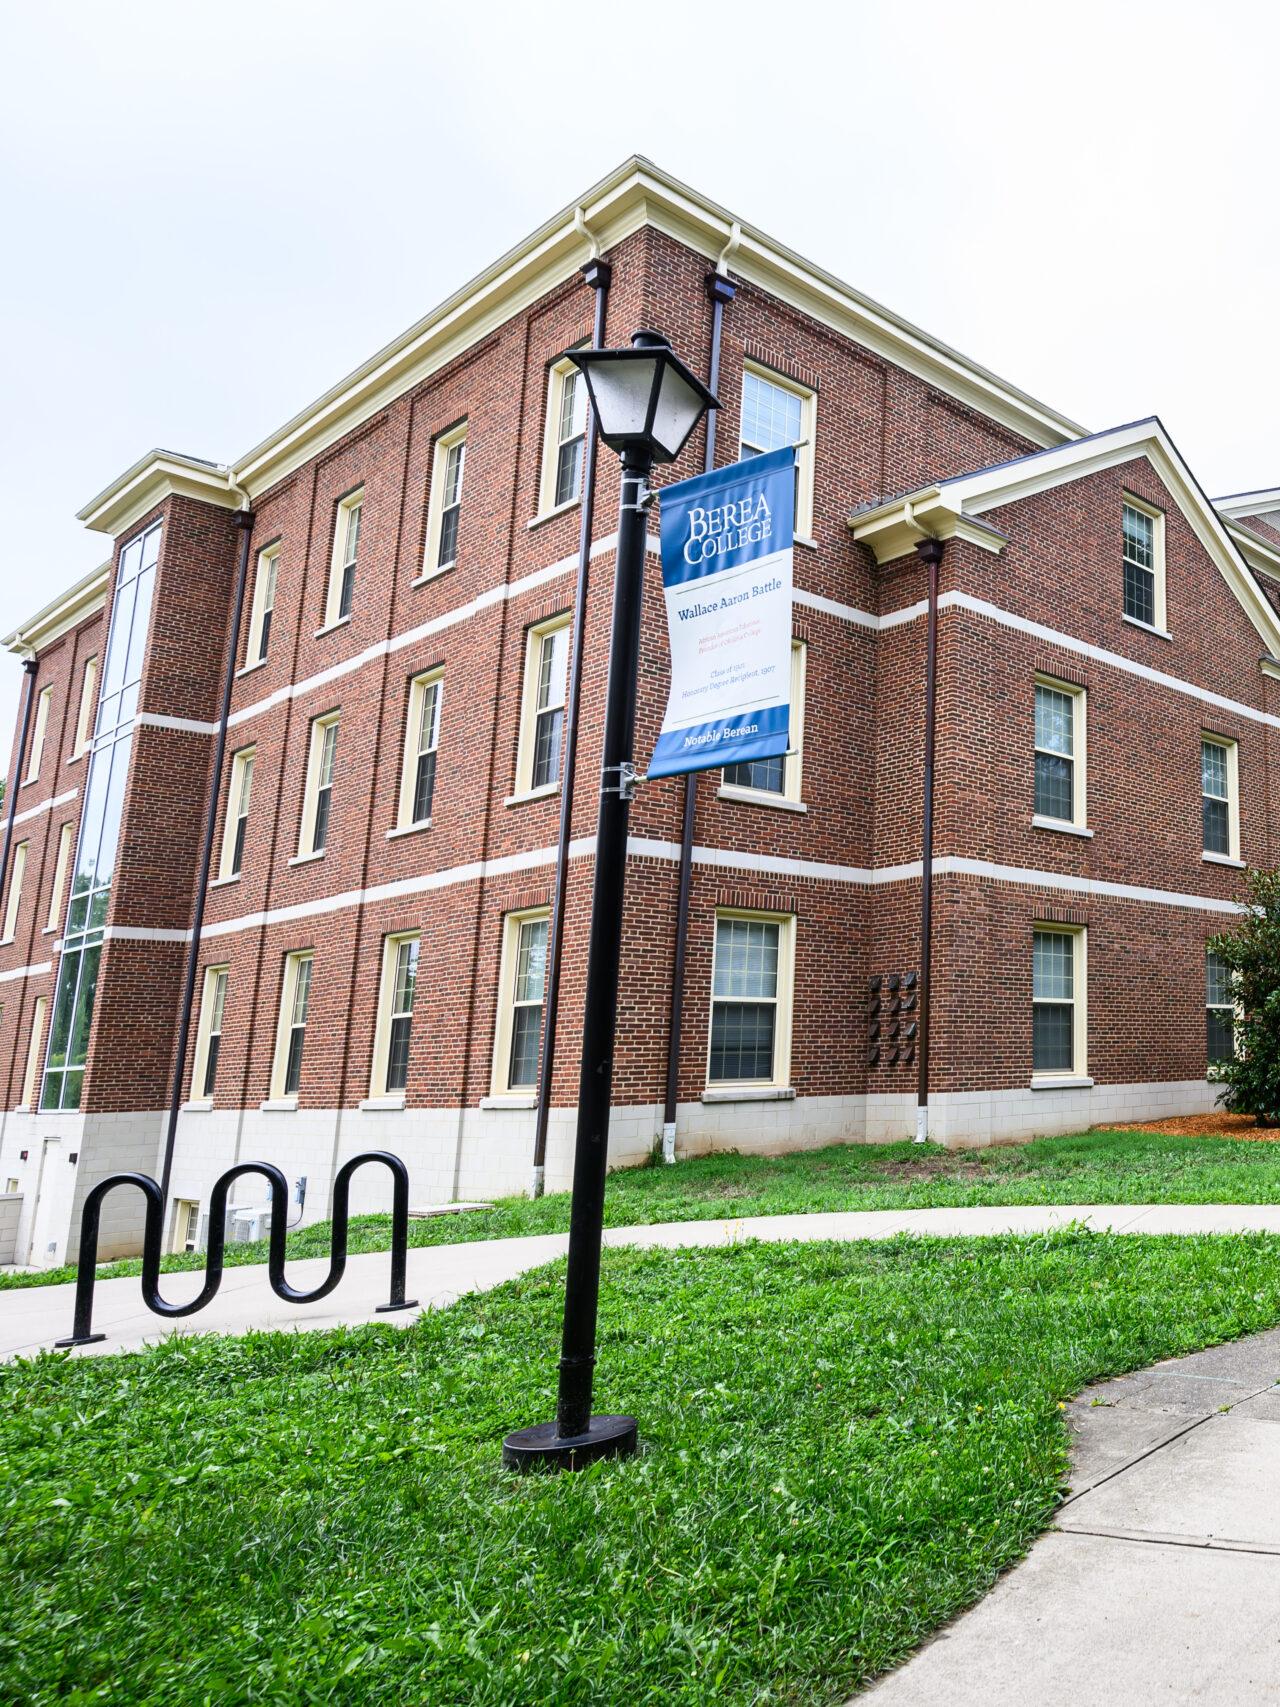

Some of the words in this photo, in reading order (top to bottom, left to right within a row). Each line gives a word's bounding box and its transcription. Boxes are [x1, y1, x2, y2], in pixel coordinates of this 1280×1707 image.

[688, 493, 771, 539] BEREA
[684, 518, 772, 565] COLLEGE
[678, 603, 718, 621] Wallace
[720, 592, 749, 609] Aaron
[752, 578, 782, 597] Battle
[709, 679, 729, 690] Degree
[684, 730, 721, 747] Notable
[722, 724, 759, 739] Berean
